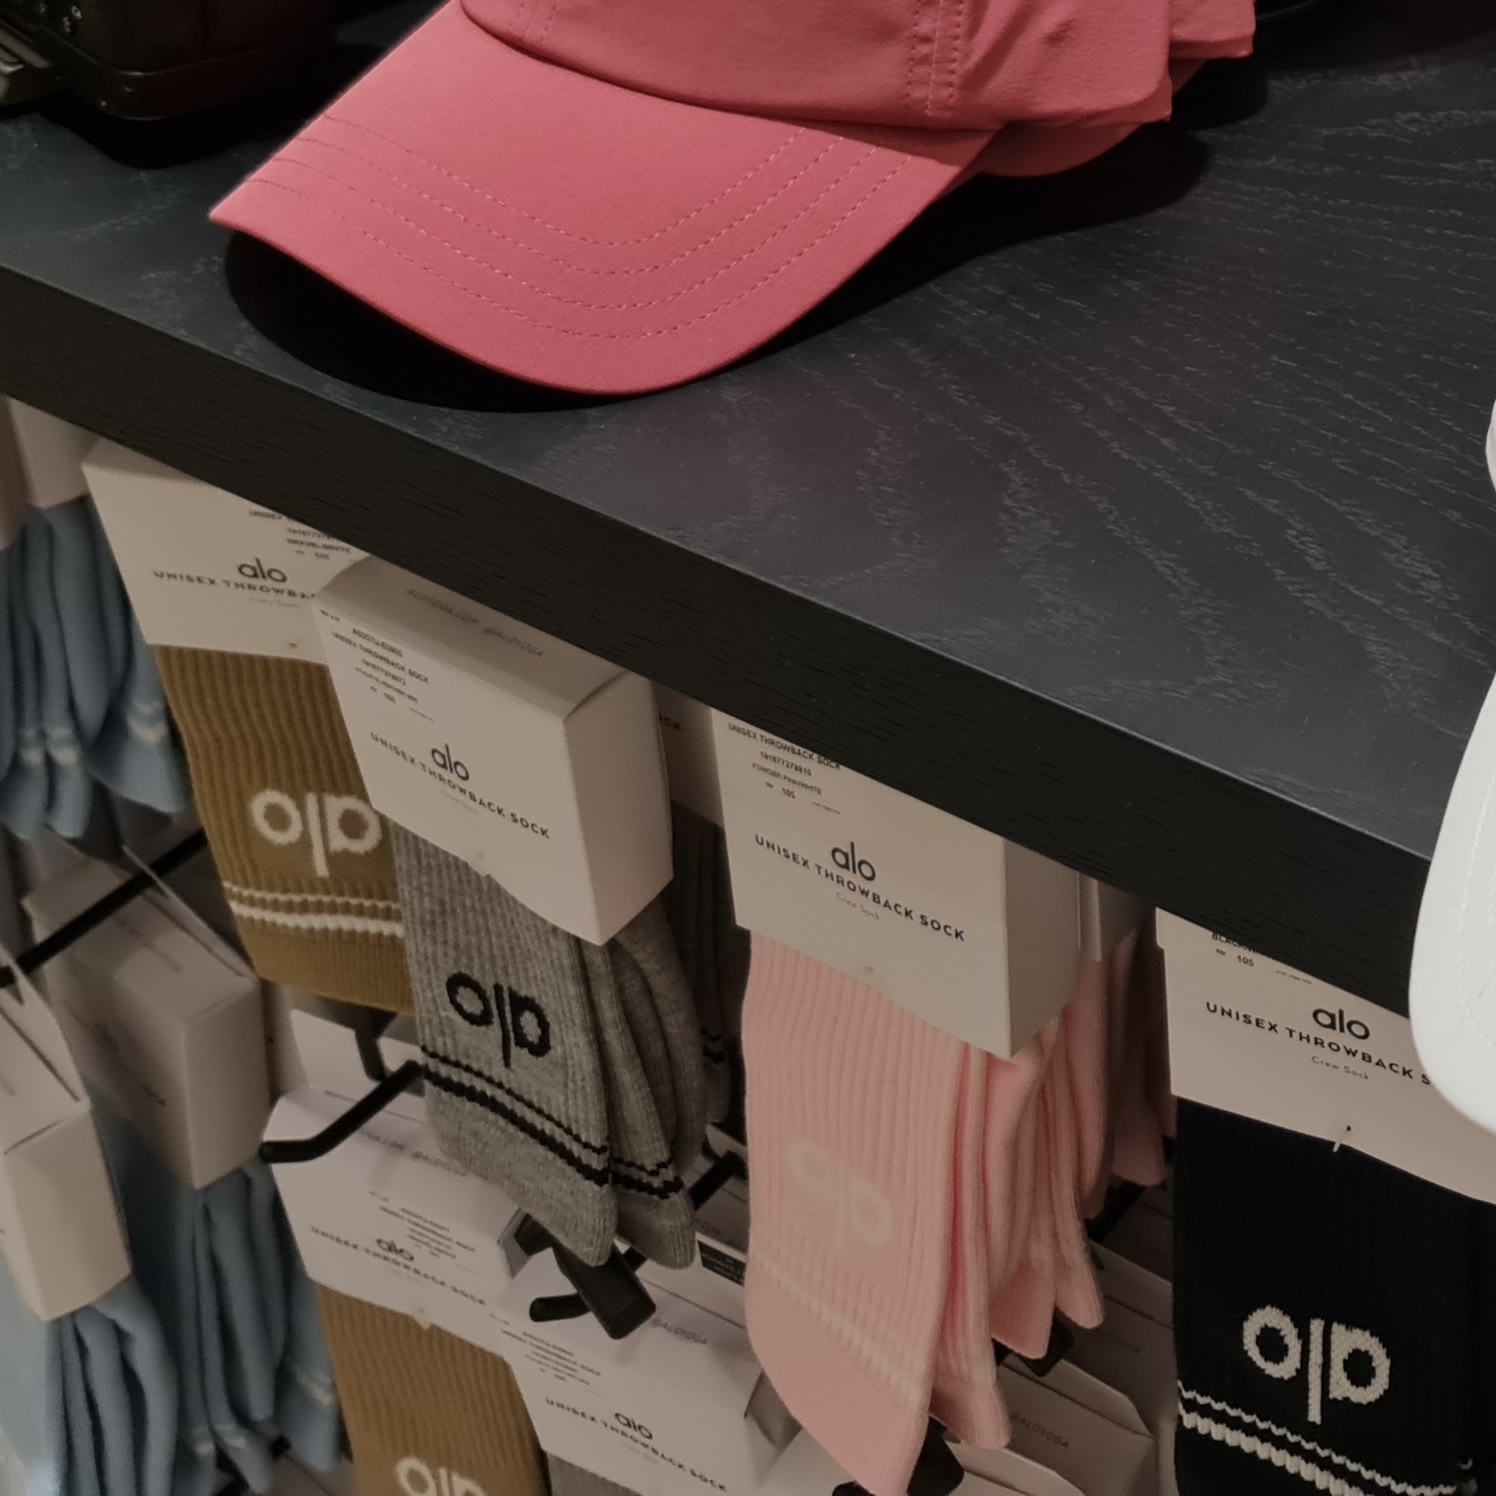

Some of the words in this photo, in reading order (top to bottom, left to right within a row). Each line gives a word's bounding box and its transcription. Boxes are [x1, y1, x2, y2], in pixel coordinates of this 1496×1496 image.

[153, 569, 219, 586] UNISEX
[222, 578, 316, 600] THROWBA
[237, 557, 288, 584] alo
[728, 722, 758, 741] UNISEX
[760, 733, 815, 763] THROWBACK
[431, 743, 470, 782] alo
[371, 731, 416, 766] UNISEX
[419, 761, 506, 819] THROWBACK
[509, 811, 551, 839] SOCK
[831, 840, 876, 882] alo
[755, 833, 810, 870] UNISEX
[814, 863, 914, 921] THROWBACK
[918, 913, 965, 943] SOCK
[1236, 954, 1255, 968] 105
[1312, 1007, 1371, 1041] alo
[1206, 1001, 1280, 1034] UNISEX
[1285, 1026, 1414, 1080] THROWBACK
[1311, 1054, 1340, 1071] Crew
[1343, 1064, 1370, 1082] Sock
[375, 1238, 415, 1262] alo
[613, 1411, 654, 1441] alo
[689, 1467, 728, 1493] SOCK
